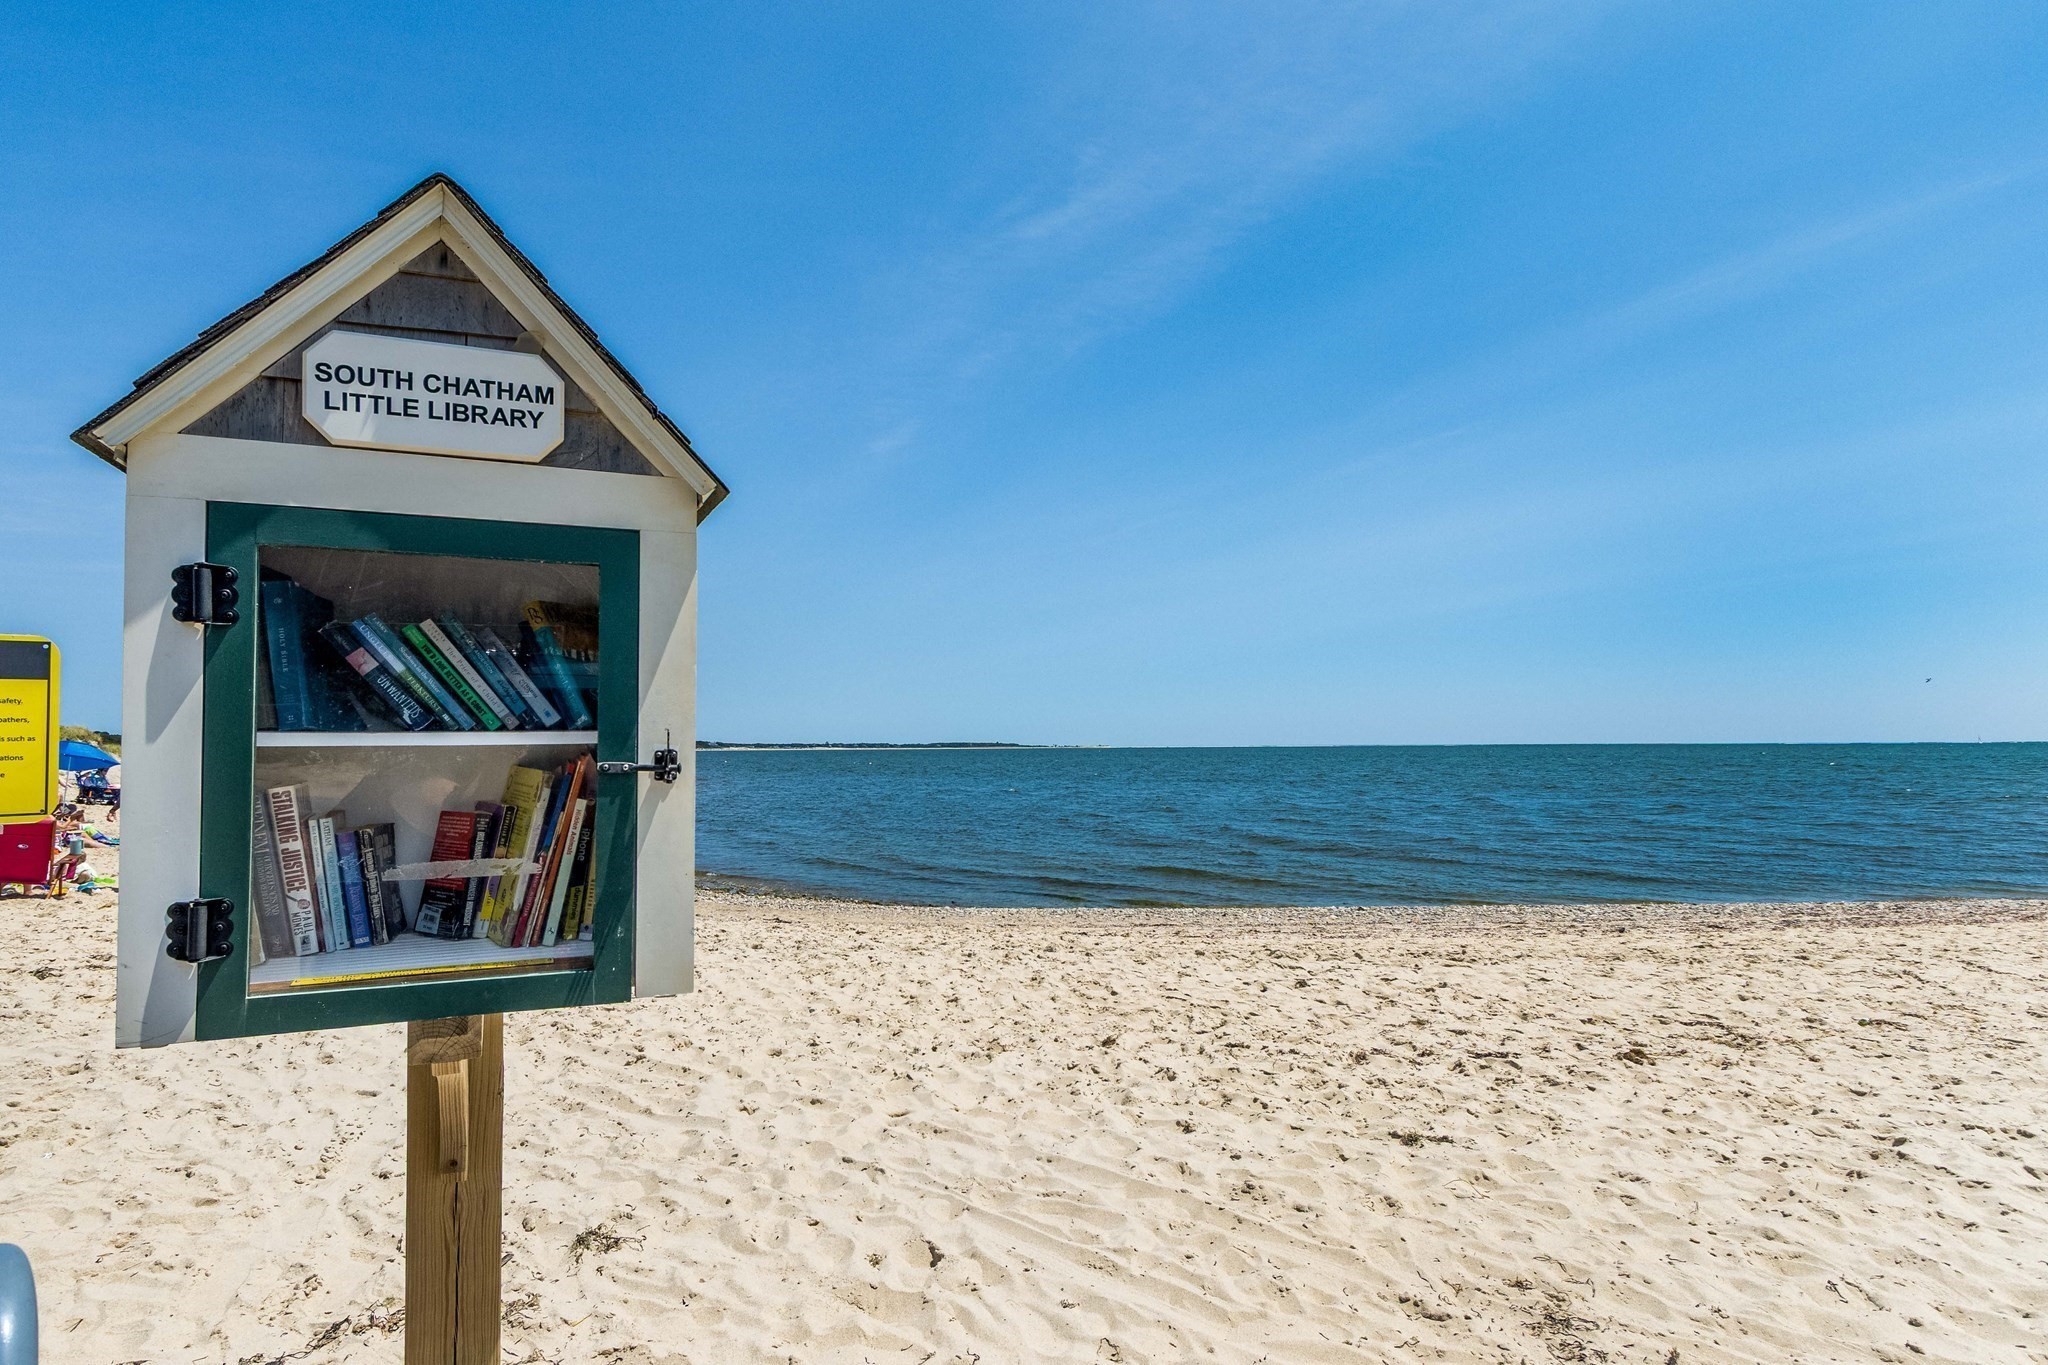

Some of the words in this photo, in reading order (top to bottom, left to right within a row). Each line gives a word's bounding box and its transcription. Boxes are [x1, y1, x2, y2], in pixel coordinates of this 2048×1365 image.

[314, 362, 414, 391] SOUTH
[422, 373, 555, 405] CHATHAM
[324, 390, 420, 418] LITTLE
[428, 400, 544, 429] LIBRARY
[281, 649, 290, 672] BIBLE
[399, 646, 417, 666] Shadows
[427, 678, 441, 693] Water
[446, 647, 457, 658] The
[457, 659, 471, 675] Price
[482, 688, 498, 705] Child
[377, 673, 424, 719] UNWANTEDS
[422, 645, 435, 659] YOU'D
[433, 657, 448, 672] LOOK
[445, 670, 463, 689] BETTER
[461, 687, 470, 696] AS
[471, 700, 487, 716] GHOST
[272, 789, 299, 844] STALKING
[323, 821, 332, 846] LATHAM
[573, 809, 582, 831] Hidden
[567, 831, 576, 856] Animals
[577, 827, 591, 862] iPhone
[281, 845, 307, 893] JUSTICE
[302, 910, 314, 933] PAUL
[570, 887, 581, 920] dummies
[291, 911, 304, 935] MONES
